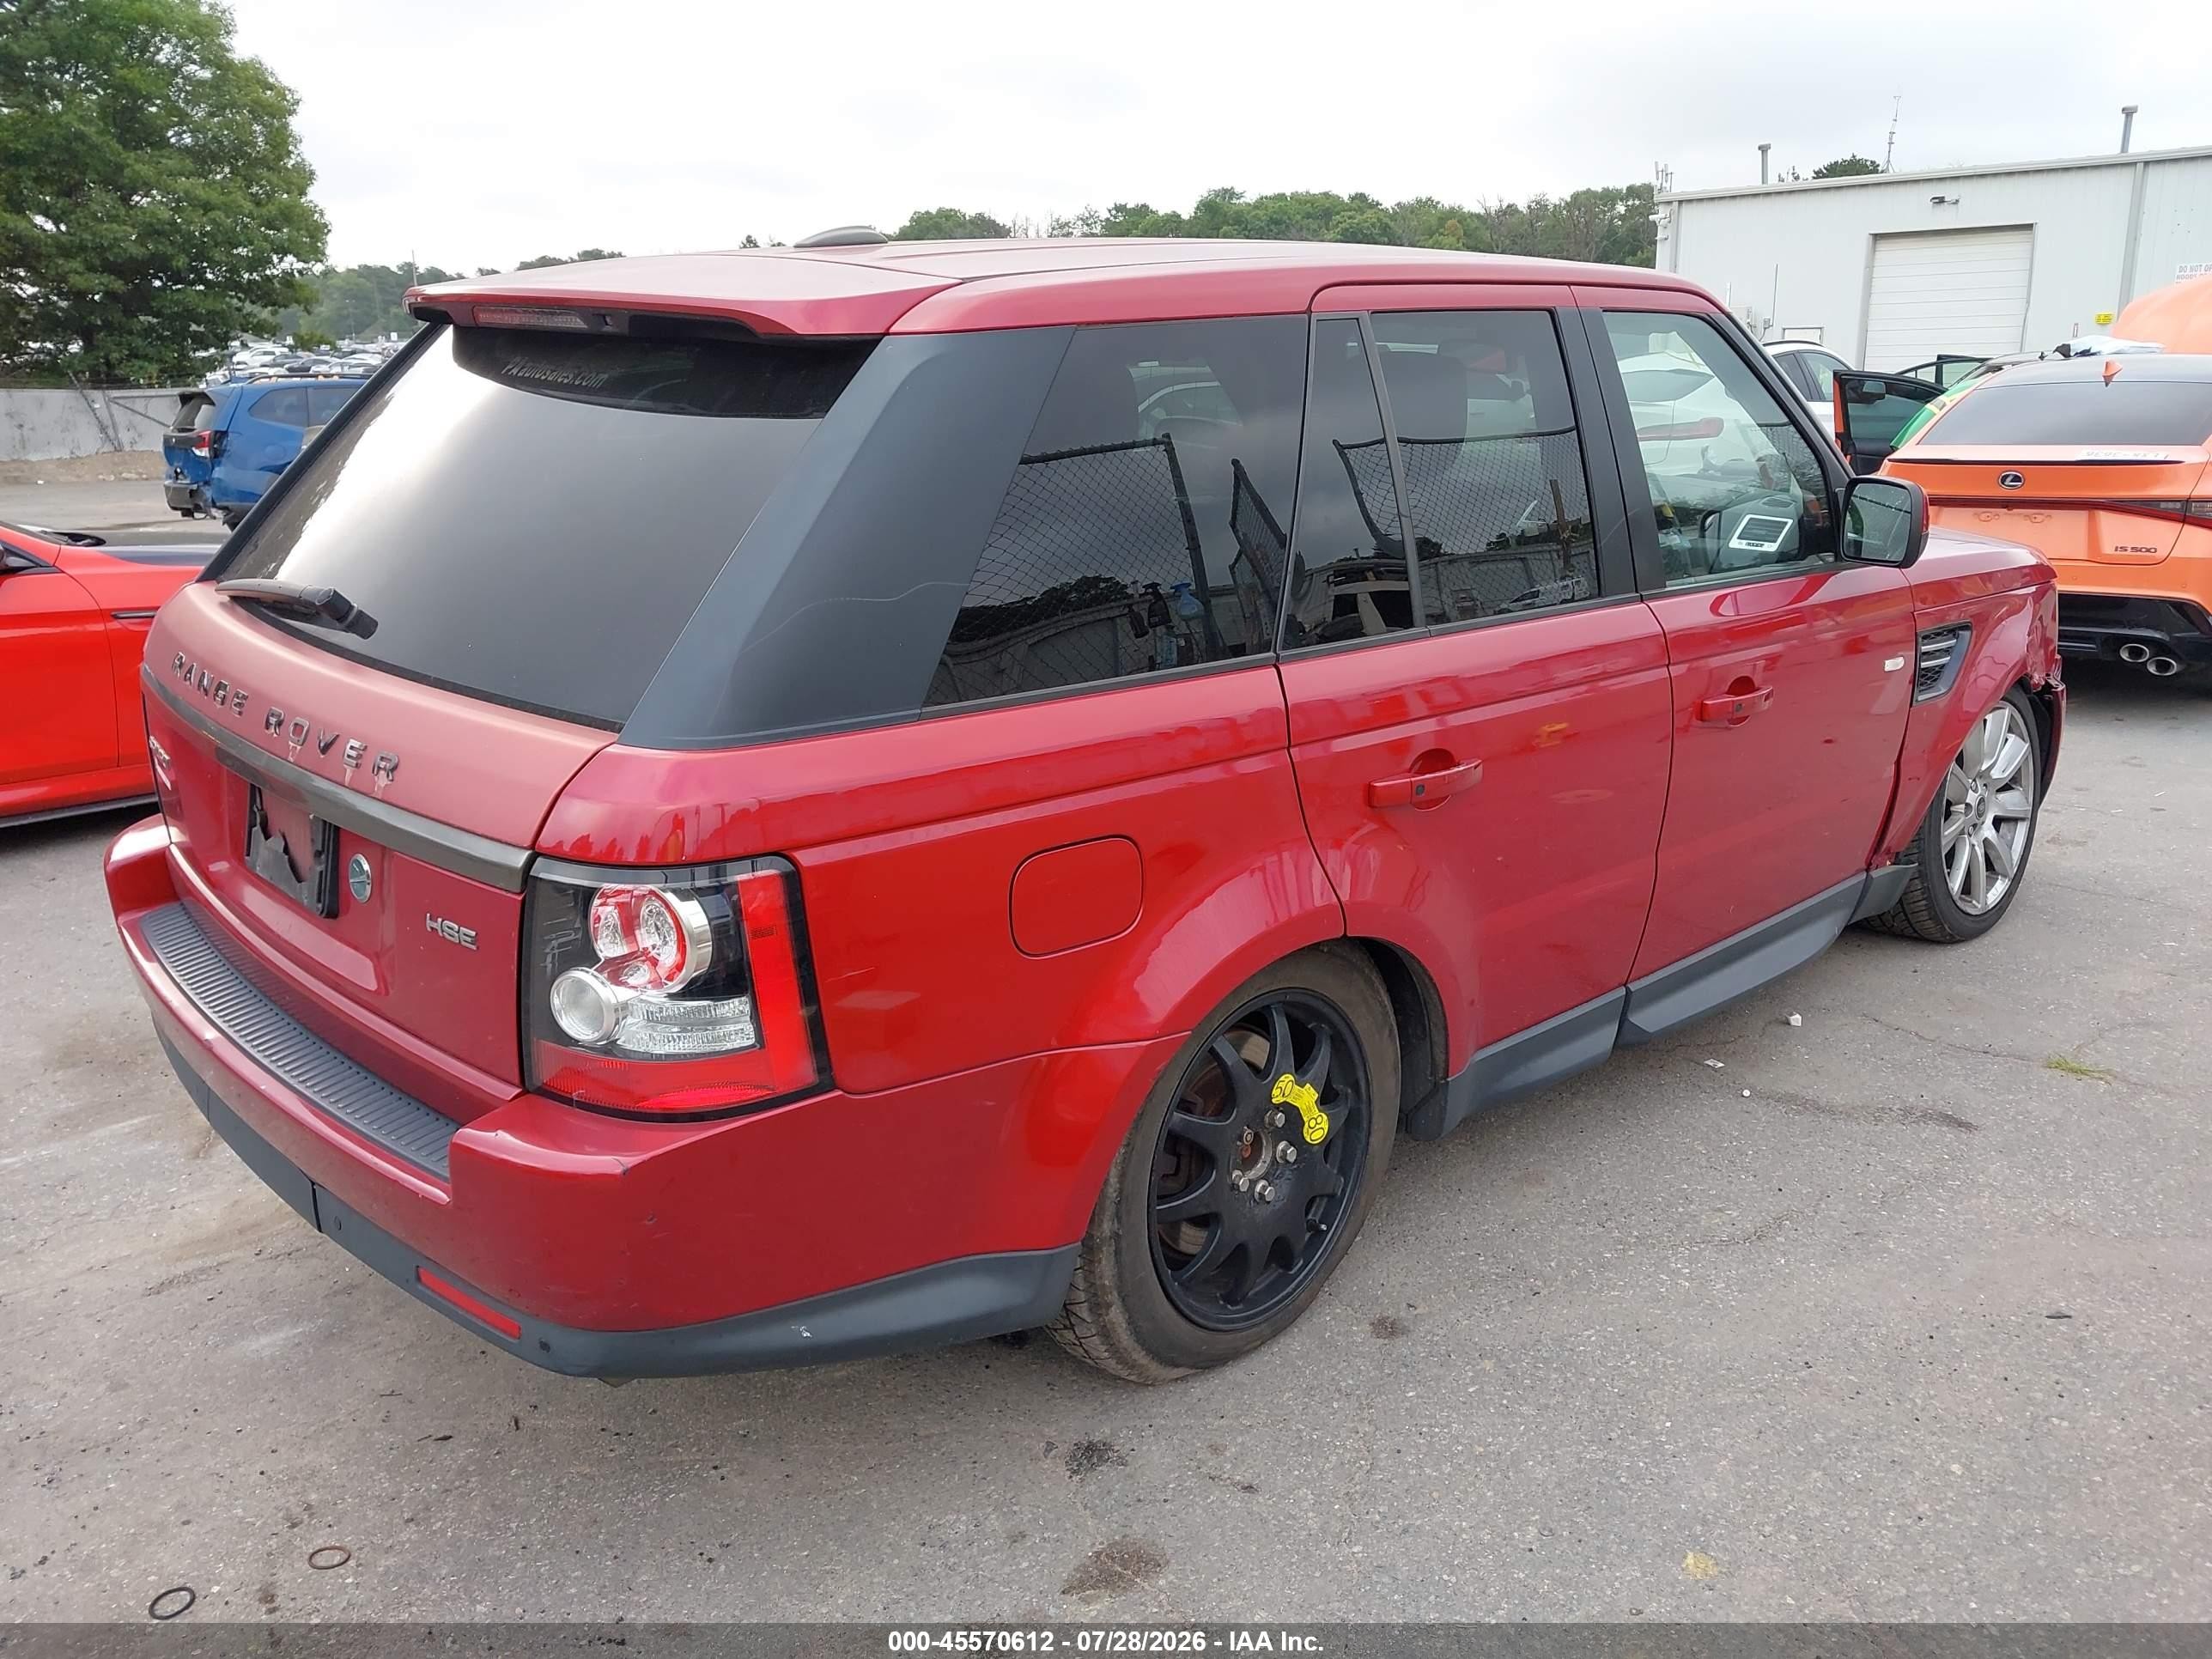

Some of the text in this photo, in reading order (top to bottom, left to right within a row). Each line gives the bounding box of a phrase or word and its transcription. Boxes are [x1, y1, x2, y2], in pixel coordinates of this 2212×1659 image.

[173, 652, 399, 782] RANGE ROVER
[426, 913, 477, 951] HSE
[1272, 1079, 1294, 1099] 50
[1308, 1115, 1324, 1141] 80
